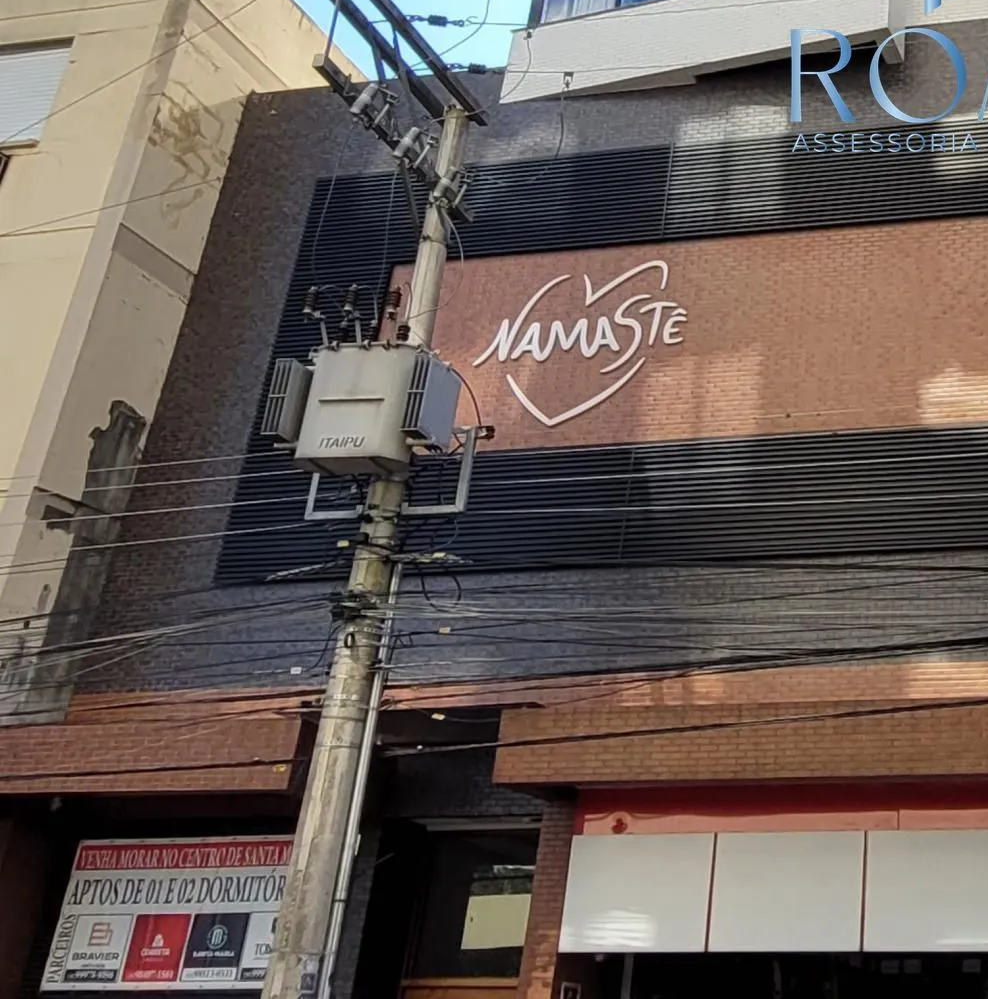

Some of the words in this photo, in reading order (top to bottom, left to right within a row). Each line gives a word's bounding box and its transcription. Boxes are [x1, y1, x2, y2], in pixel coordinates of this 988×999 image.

[318, 436, 366, 449] ITAIPU
[79, 849, 116, 868] VENHA
[119, 848, 159, 868] MORAR
[159, 849, 178, 866] NO
[179, 848, 226, 866] CENTRO
[226, 847, 243, 866] DE
[243, 845, 282, 865] SANTA
[68, 877, 122, 905] APTOS
[120, 877, 147, 904] DE
[145, 877, 163, 904] 01
[164, 877, 178, 903] E
[176, 876, 196, 903] 02
[196, 868, 286, 903] DORMITÓR
[46, 914, 77, 983] PARCEIROS
[71, 951, 120, 961] BRAVIER
